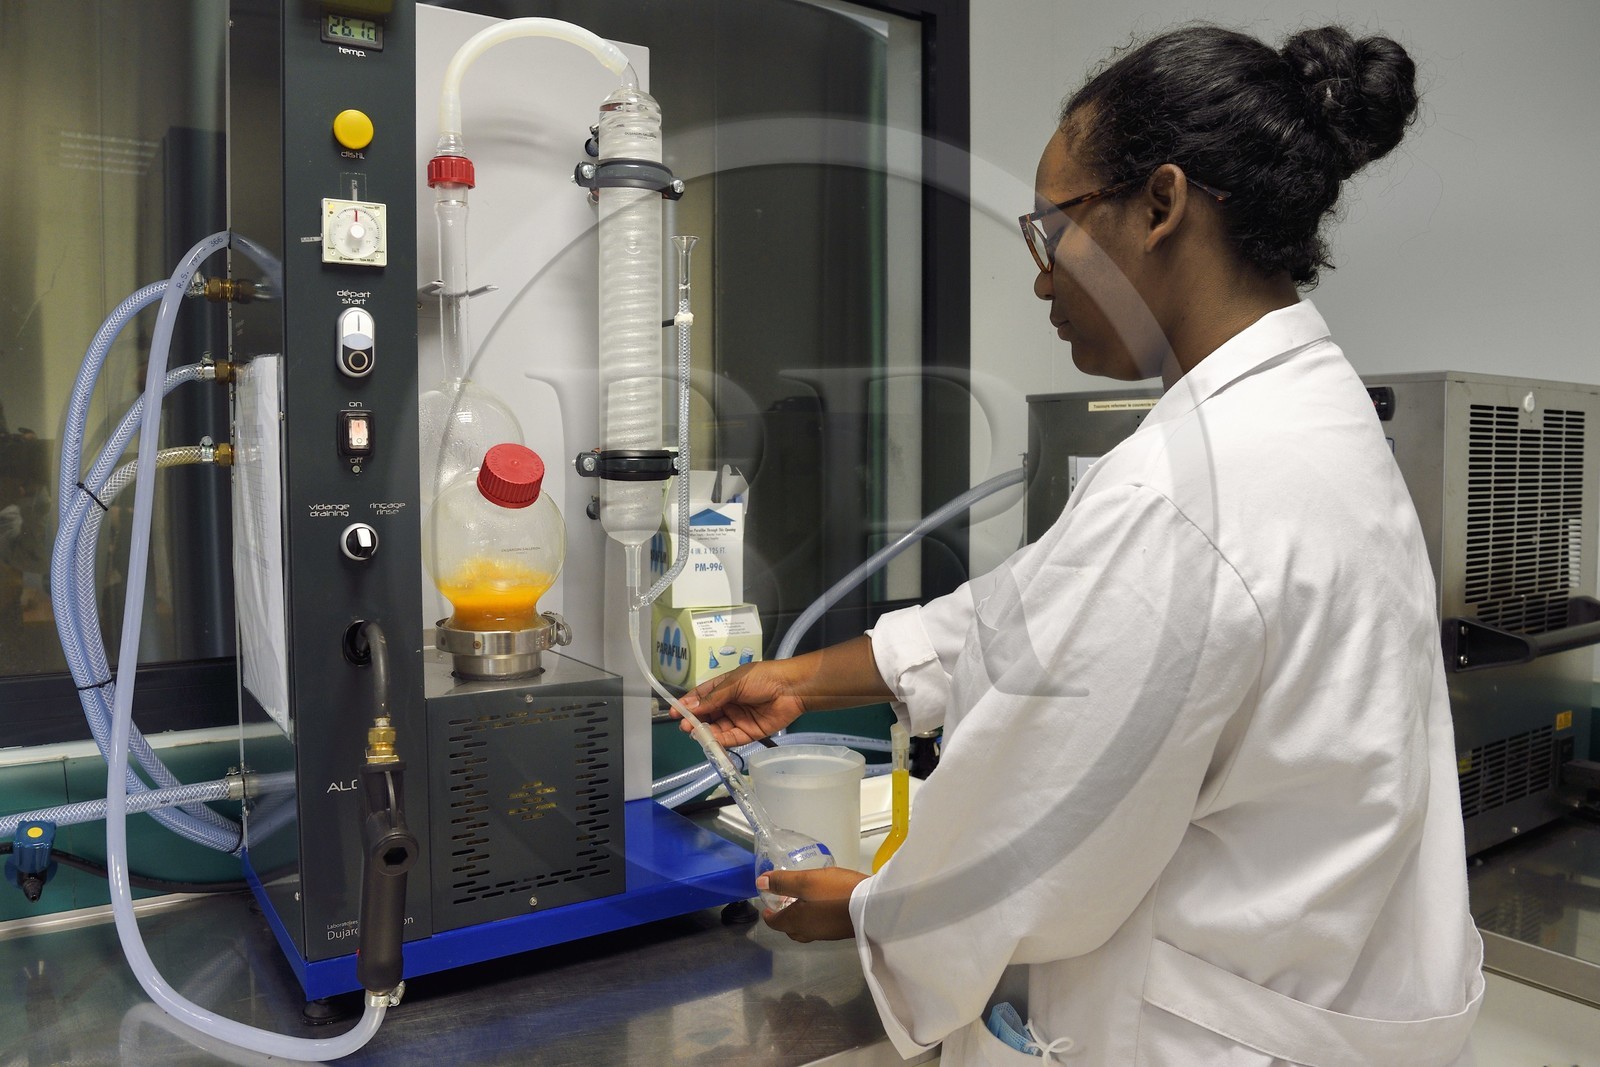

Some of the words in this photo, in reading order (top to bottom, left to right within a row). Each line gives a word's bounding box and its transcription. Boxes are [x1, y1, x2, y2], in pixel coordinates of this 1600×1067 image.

[338, 46, 367, 57] temp.
[337, 289, 371, 300] départ
[341, 297, 366, 305] start
[308, 503, 350, 511] vidange
[309, 510, 350, 518] draining
[694, 562, 723, 572] PM-996
[656, 641, 688, 661] PARAFILM
